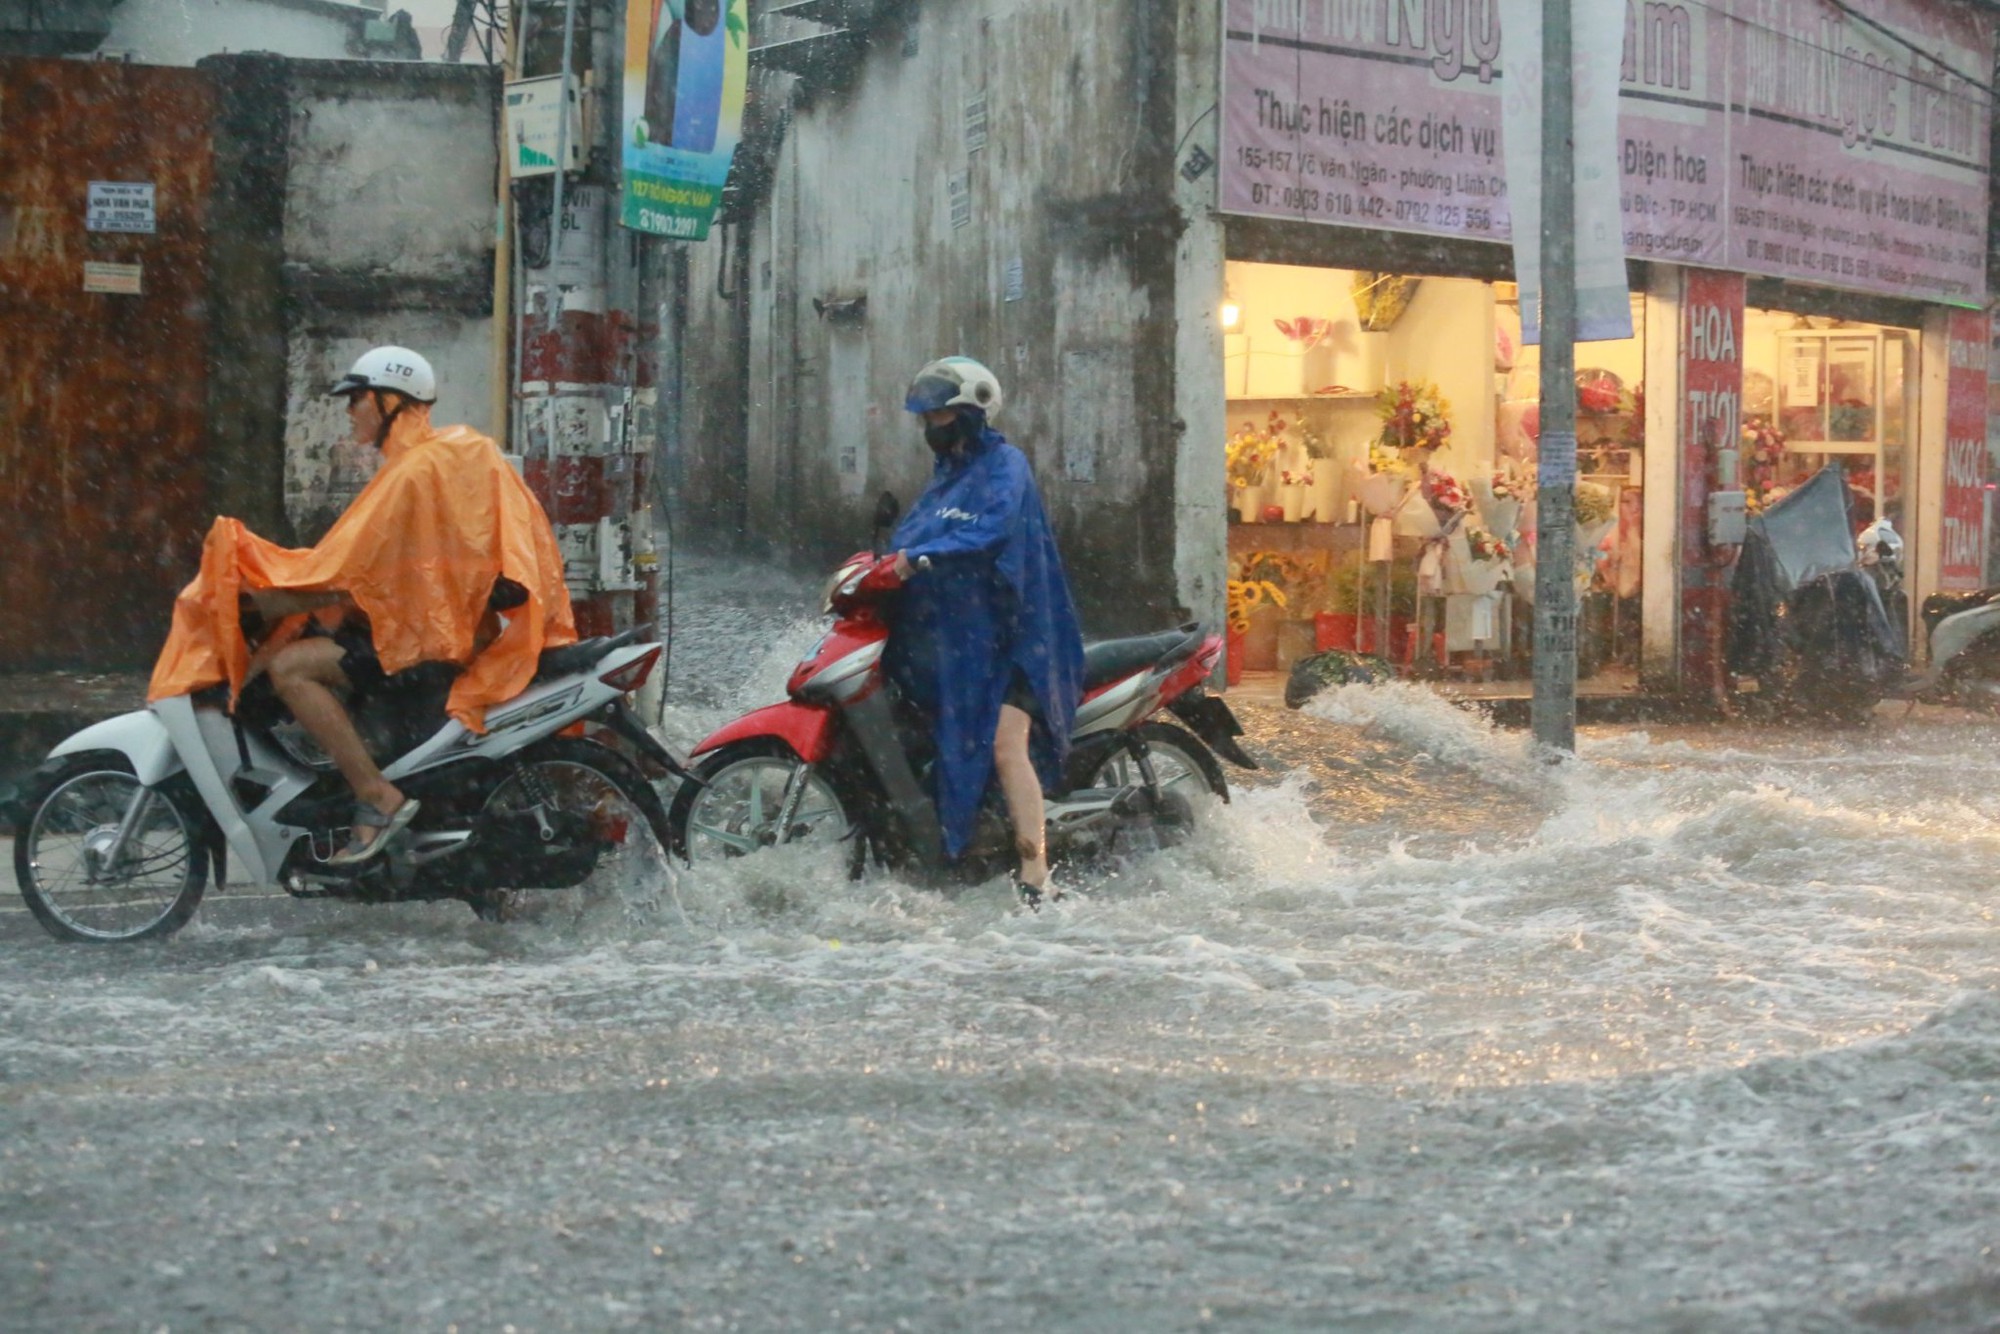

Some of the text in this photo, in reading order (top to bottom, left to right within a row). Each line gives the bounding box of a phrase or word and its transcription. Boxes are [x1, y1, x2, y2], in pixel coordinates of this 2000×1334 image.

[1237, 146, 1292, 172] 155-157
[1319, 97, 1366, 146] hiện
[1375, 106, 1412, 147] các
[1419, 112, 1464, 159] dịch
[1472, 127, 1496, 165] vụ
[1623, 139, 1667, 185] Điện
[1673, 145, 1706, 184] hoa
[560, 212, 581, 231] 6L
[1690, 304, 1736, 362] HOA
